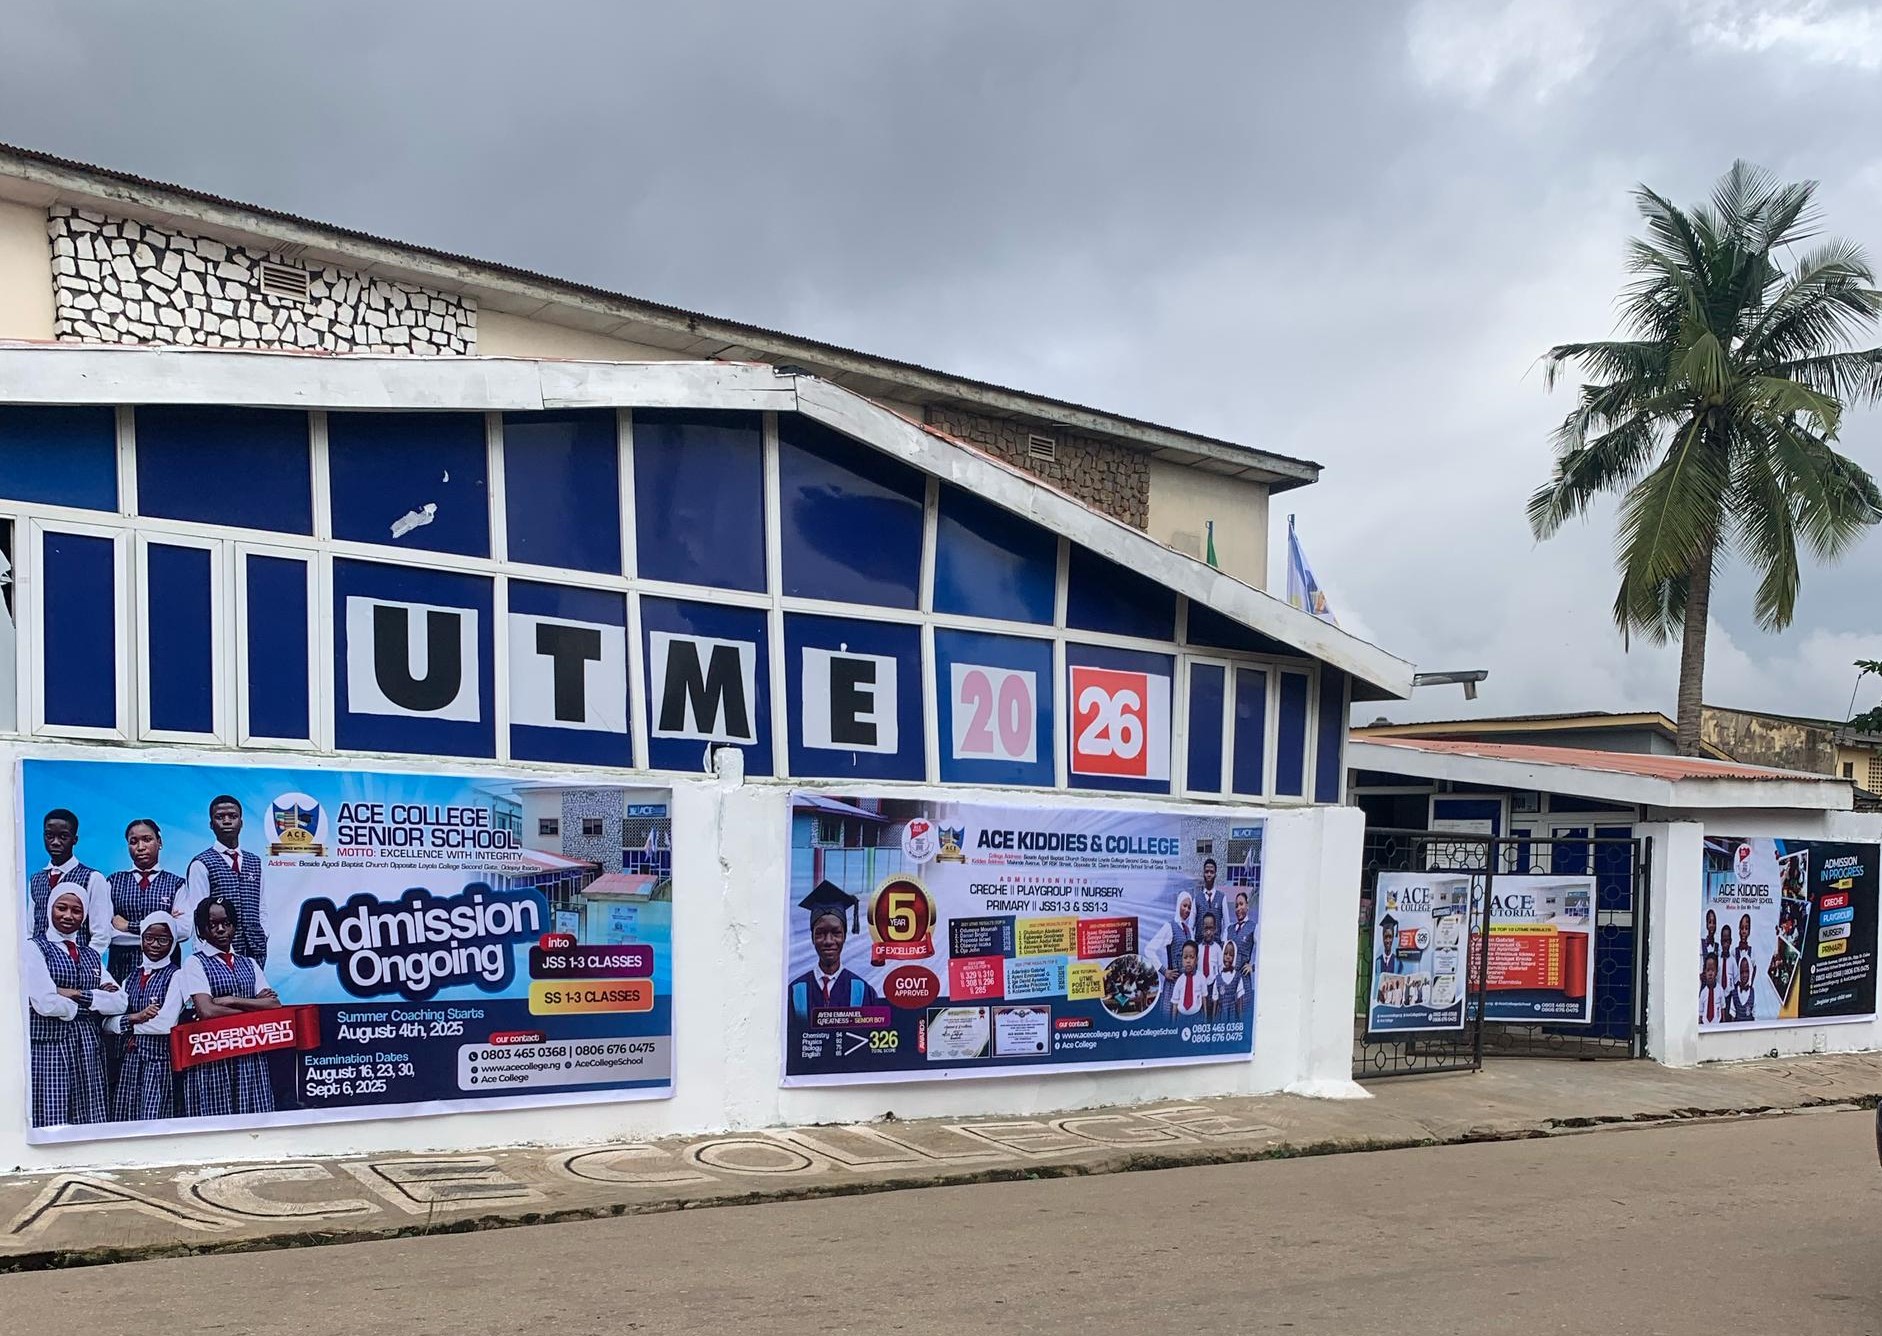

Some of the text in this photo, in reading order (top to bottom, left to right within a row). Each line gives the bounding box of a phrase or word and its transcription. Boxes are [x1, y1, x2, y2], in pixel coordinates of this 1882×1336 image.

[373, 606, 877, 746] UTME
[338, 803, 488, 828] ACE COLLEGE
[338, 825, 519, 850] SENIOR SCHOOL
[977, 829, 1179, 856] ACE KIDDIES & COLLEGE
[337, 848, 523, 861] MOTTO: EXCELLENCE WITH INTEGRITY
[299, 860, 320, 868] Beside
[321, 861, 339, 870] Agodi
[341, 861, 364, 870] Baptist
[365, 861, 389, 869] Church
[390, 862, 417, 871] Opposite
[418, 862, 437, 871] Loyola
[438, 863, 460, 872] College
[461, 863, 482, 871] Second
[1824, 856, 1858, 869] ADMISSION
[1820, 866, 1864, 881] IN PROGRESS
[969, 883, 1124, 898] CRECHE PLAYGROUP NURSERY
[1401, 888, 1430, 904] ACE
[1719, 884, 1769, 897] ACE KIDDIES
[986, 900, 1030, 911] PRIMARY
[1400, 904, 1431, 912] COLLEGE
[1490, 894, 1533, 910] ACE
[1823, 897, 1844, 907] CRECHE
[888, 892, 916, 940] 5
[1490, 909, 1536, 917] UTORIAL
[1823, 910, 1852, 922] PLAYGROUP
[303, 894, 540, 956] Admission
[889, 918, 906, 927] YEAR
[1822, 927, 1845, 938] NURSERY
[548, 937, 570, 949] into
[875, 945, 927, 955] OF EXCELLENCE
[1821, 942, 1844, 954] PRIMARY
[349, 941, 505, 991] Ongoing
[542, 955, 643, 969] JSS 1-3 CLASSES
[895, 977, 928, 990] GOVT
[544, 990, 641, 1004] SS 1-3 CLASSES
[894, 989, 929, 997] APPROVED
[337, 1008, 485, 1024] Summer Coaching Starts
[188, 1020, 292, 1044] GOVERNMENT
[337, 1022, 464, 1044] August 4th, 2025
[1192, 1022, 1244, 1033] 0803 465 0368
[190, 1030, 294, 1056] APPROVED
[495, 1034, 540, 1044] our contact
[802, 1032, 830, 1040] Chemistry
[869, 1030, 898, 1048] 326
[1191, 1032, 1243, 1043] 0806 676 0475
[480, 1042, 656, 1061] 0803 465 0368 0806 676 0475
[1074, 1040, 1098, 1050] College
[304, 1052, 409, 1066] Examination Dates
[480, 1057, 644, 1073] www.acecollege.ng AceCollegeSchool
[306, 1062, 415, 1084] August 16, 23, 30,
[480, 1073, 530, 1084] Ace College
[306, 1079, 387, 1098] Sept 6, 2025
[2, 1105, 1288, 1237] ACE COLLEGE
